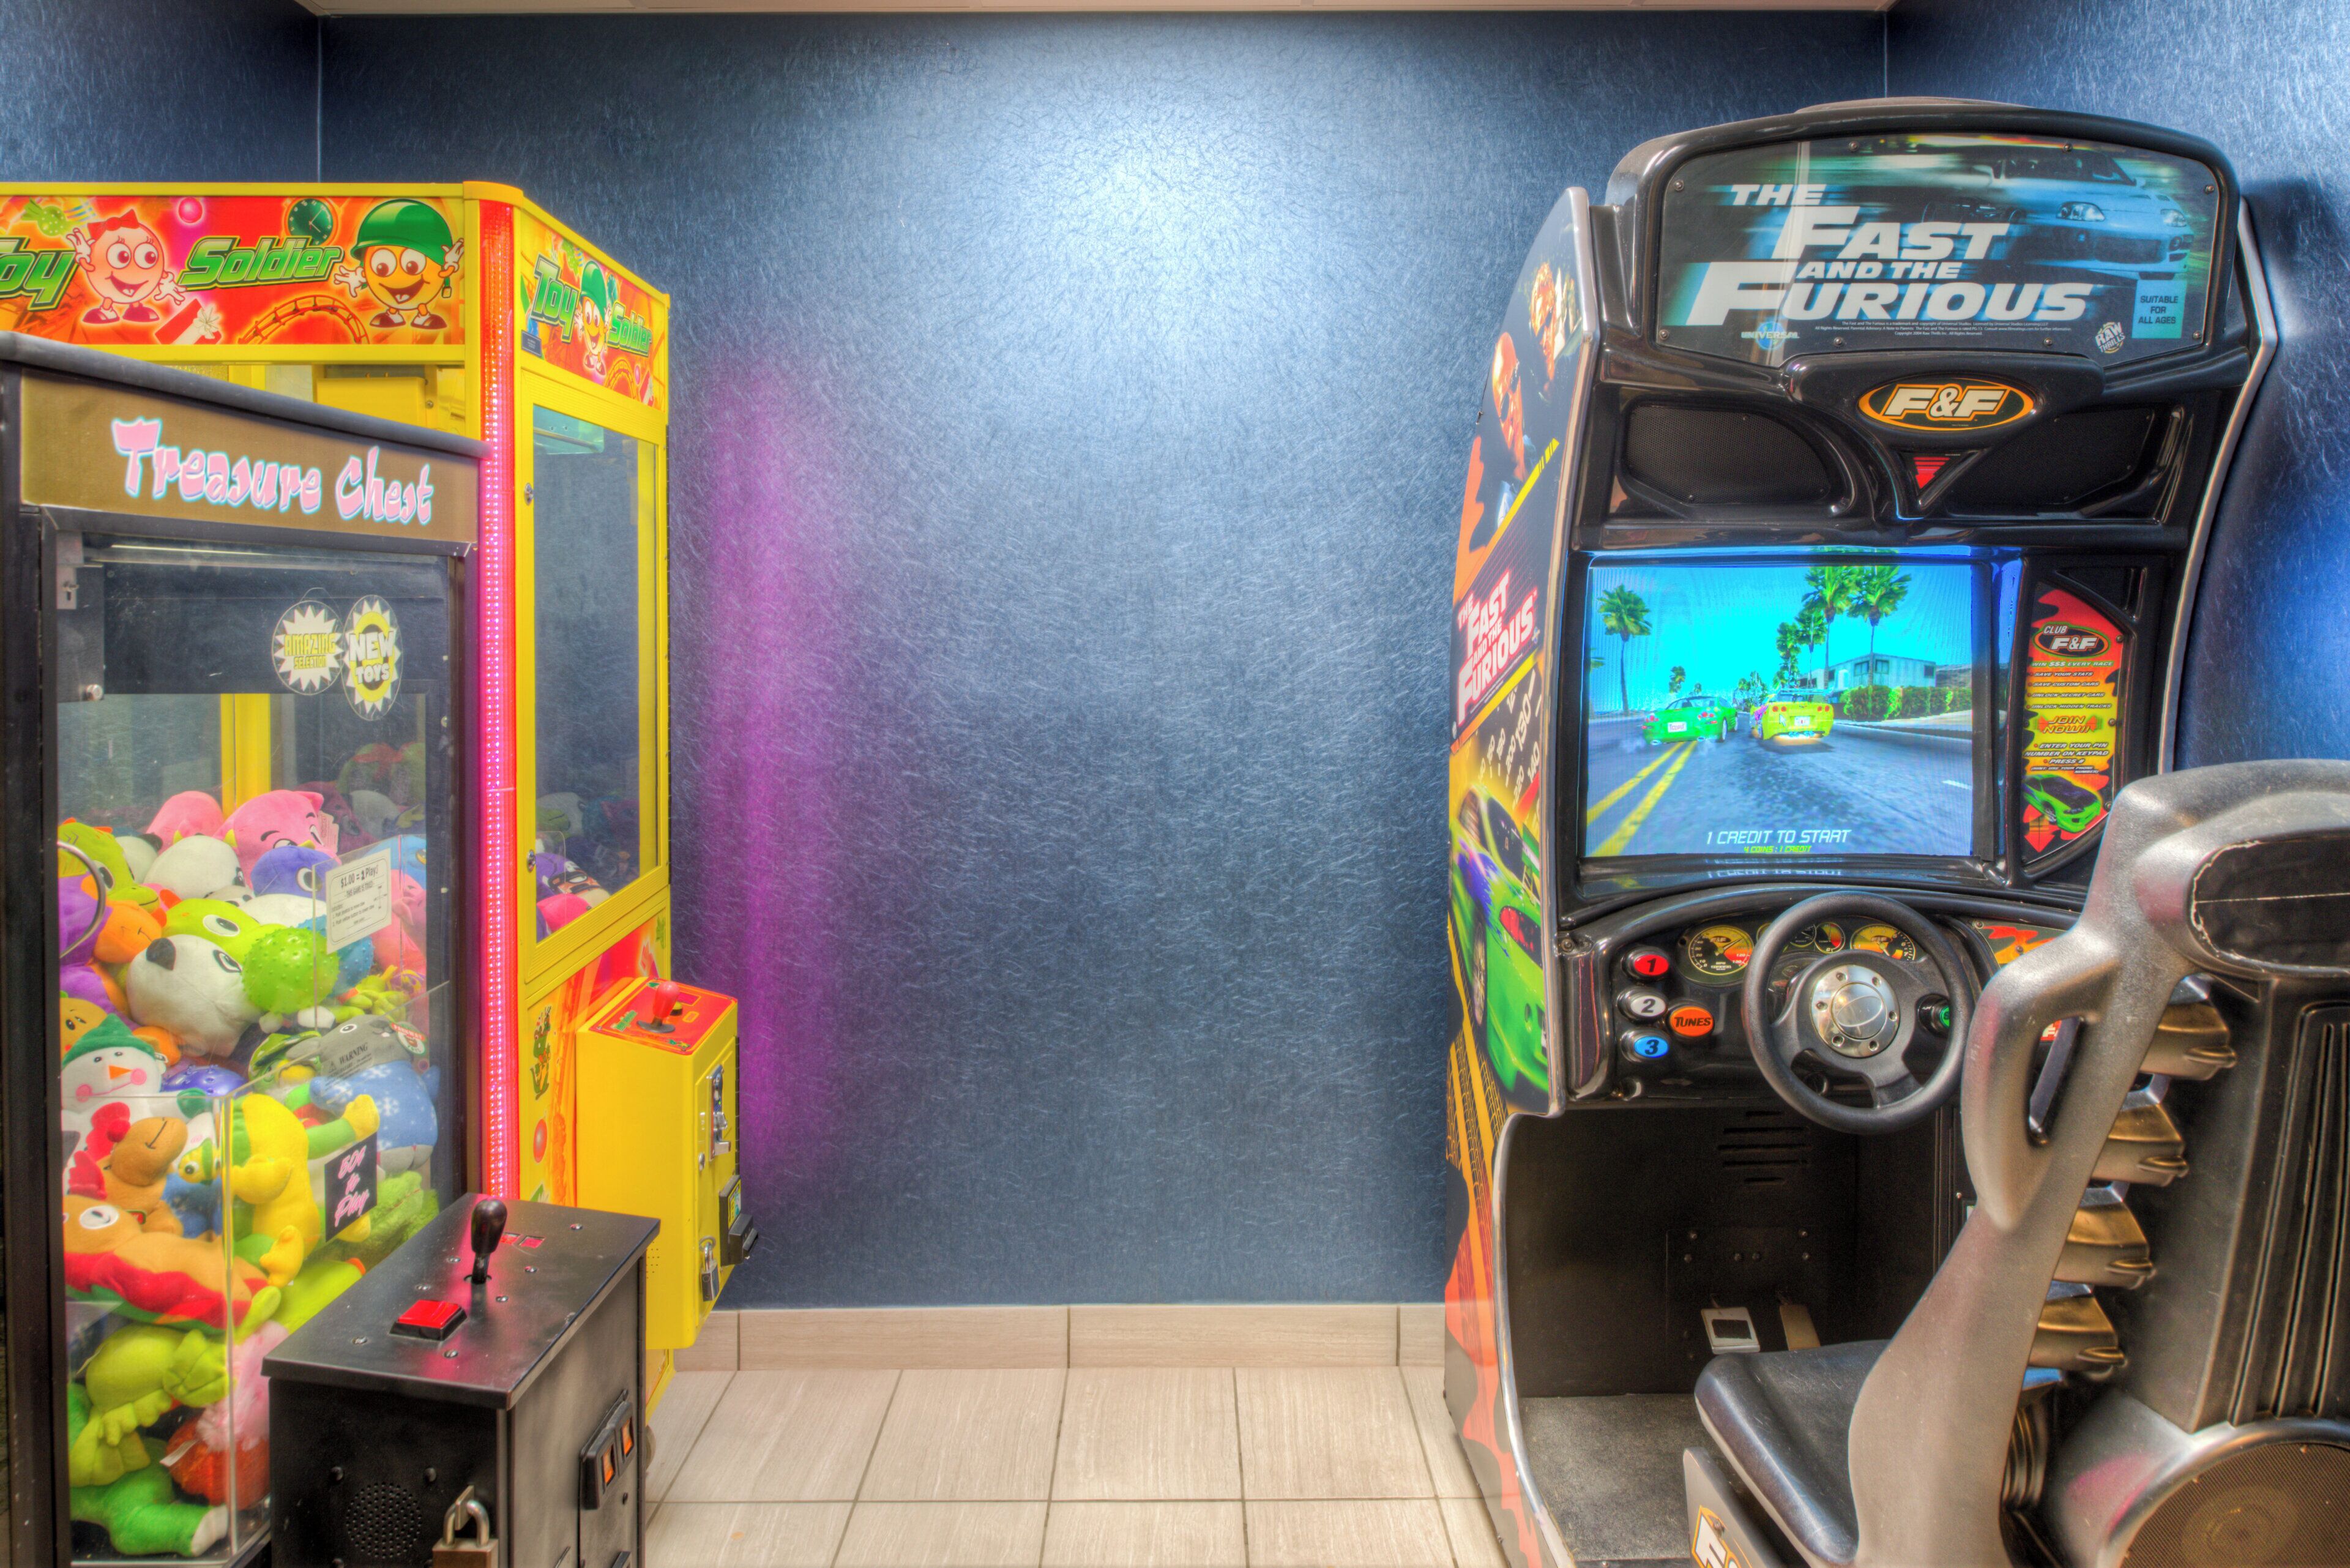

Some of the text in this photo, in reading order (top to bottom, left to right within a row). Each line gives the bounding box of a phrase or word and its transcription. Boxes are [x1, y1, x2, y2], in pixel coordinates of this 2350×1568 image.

[1731, 184, 1826, 206] THE
[1772, 206, 2010, 259] FAST
[0, 236, 344, 310] oy Soldier
[1796, 262, 1963, 279] AND THE
[531, 253, 652, 357] Toy Soldier
[1685, 262, 2094, 325] FURIOUS
[2095, 322, 2122, 346] RAW
[2098, 333, 2125, 353] THRILLS
[1883, 386, 2009, 419] F&F
[111, 417, 433, 525] Treasure Chest
[1458, 592, 1474, 630] THE
[1467, 571, 1510, 659] FAST
[2043, 625, 2067, 634] CLUB
[284, 633, 336, 657] AMAZING
[348, 630, 395, 662] NEW
[1473, 616, 1502, 668] AND THE
[2051, 637, 2097, 650] F&F
[294, 655, 327, 670] SELECTION
[1458, 595, 1533, 726] FURIOUS
[356, 663, 390, 684] TOYS
[1707, 829, 1852, 845] 1 CREDIT TO START
[340, 872, 355, 889] $1.00
[1647, 958, 1657, 973] 1
[1641, 998, 1656, 1014] 2
[1674, 1017, 1712, 1028] TUNES
[338, 1042, 368, 1066] WARNING
[1644, 1039, 1660, 1055] 3
[345, 1172, 361, 1195] to
[334, 1189, 370, 1228] Play
